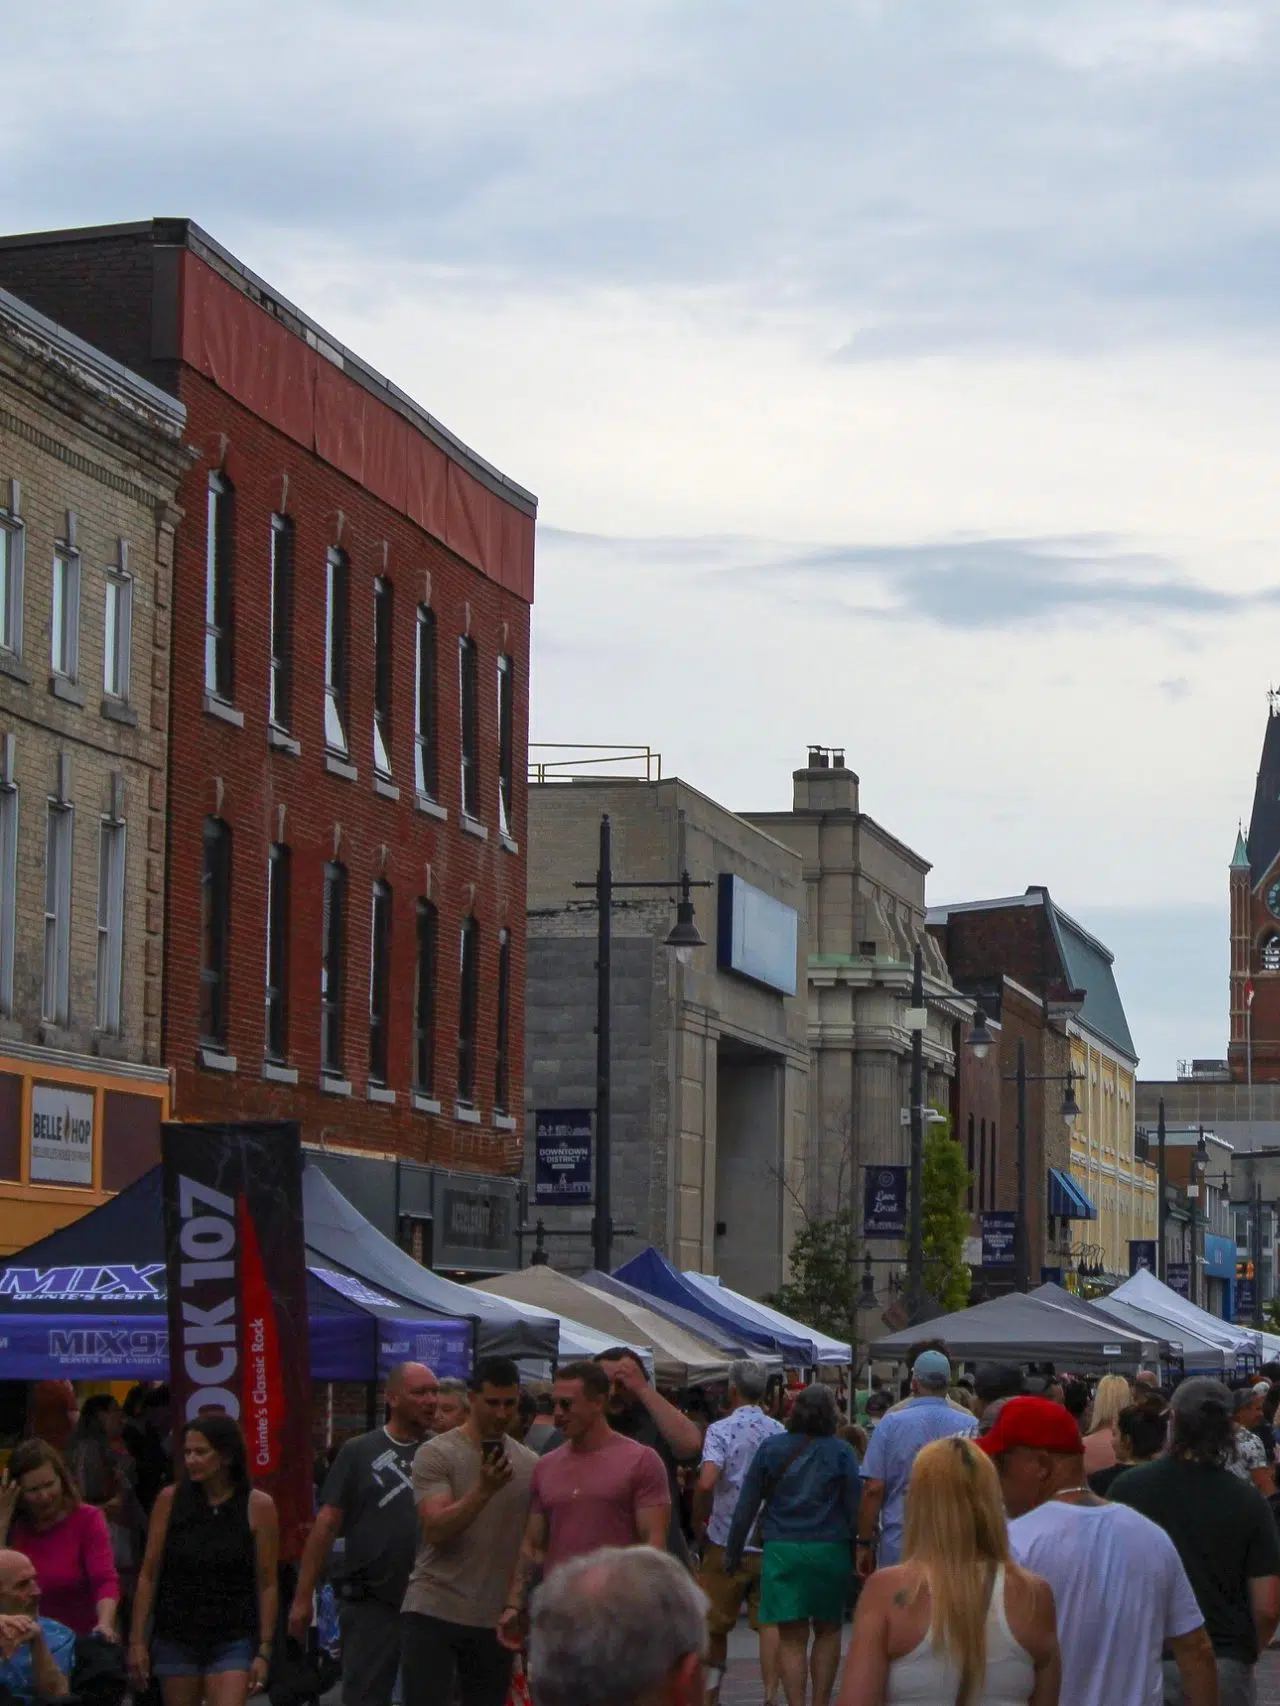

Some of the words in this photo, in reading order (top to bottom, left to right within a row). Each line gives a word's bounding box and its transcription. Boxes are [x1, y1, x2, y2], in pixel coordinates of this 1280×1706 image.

[33, 1112, 62, 1141] BELLE
[71, 1118, 91, 1144] HOP
[178, 1174, 236, 1288] 107
[0, 1263, 167, 1294] MIX
[12, 1293, 96, 1301] QUINTE'S
[101, 1293, 147, 1301] BEST
[249, 1317, 266, 1353] Rock
[183, 1296, 240, 1421] OCK
[251, 1353, 269, 1405] Classic
[249, 1406, 271, 1466] Quinte's
